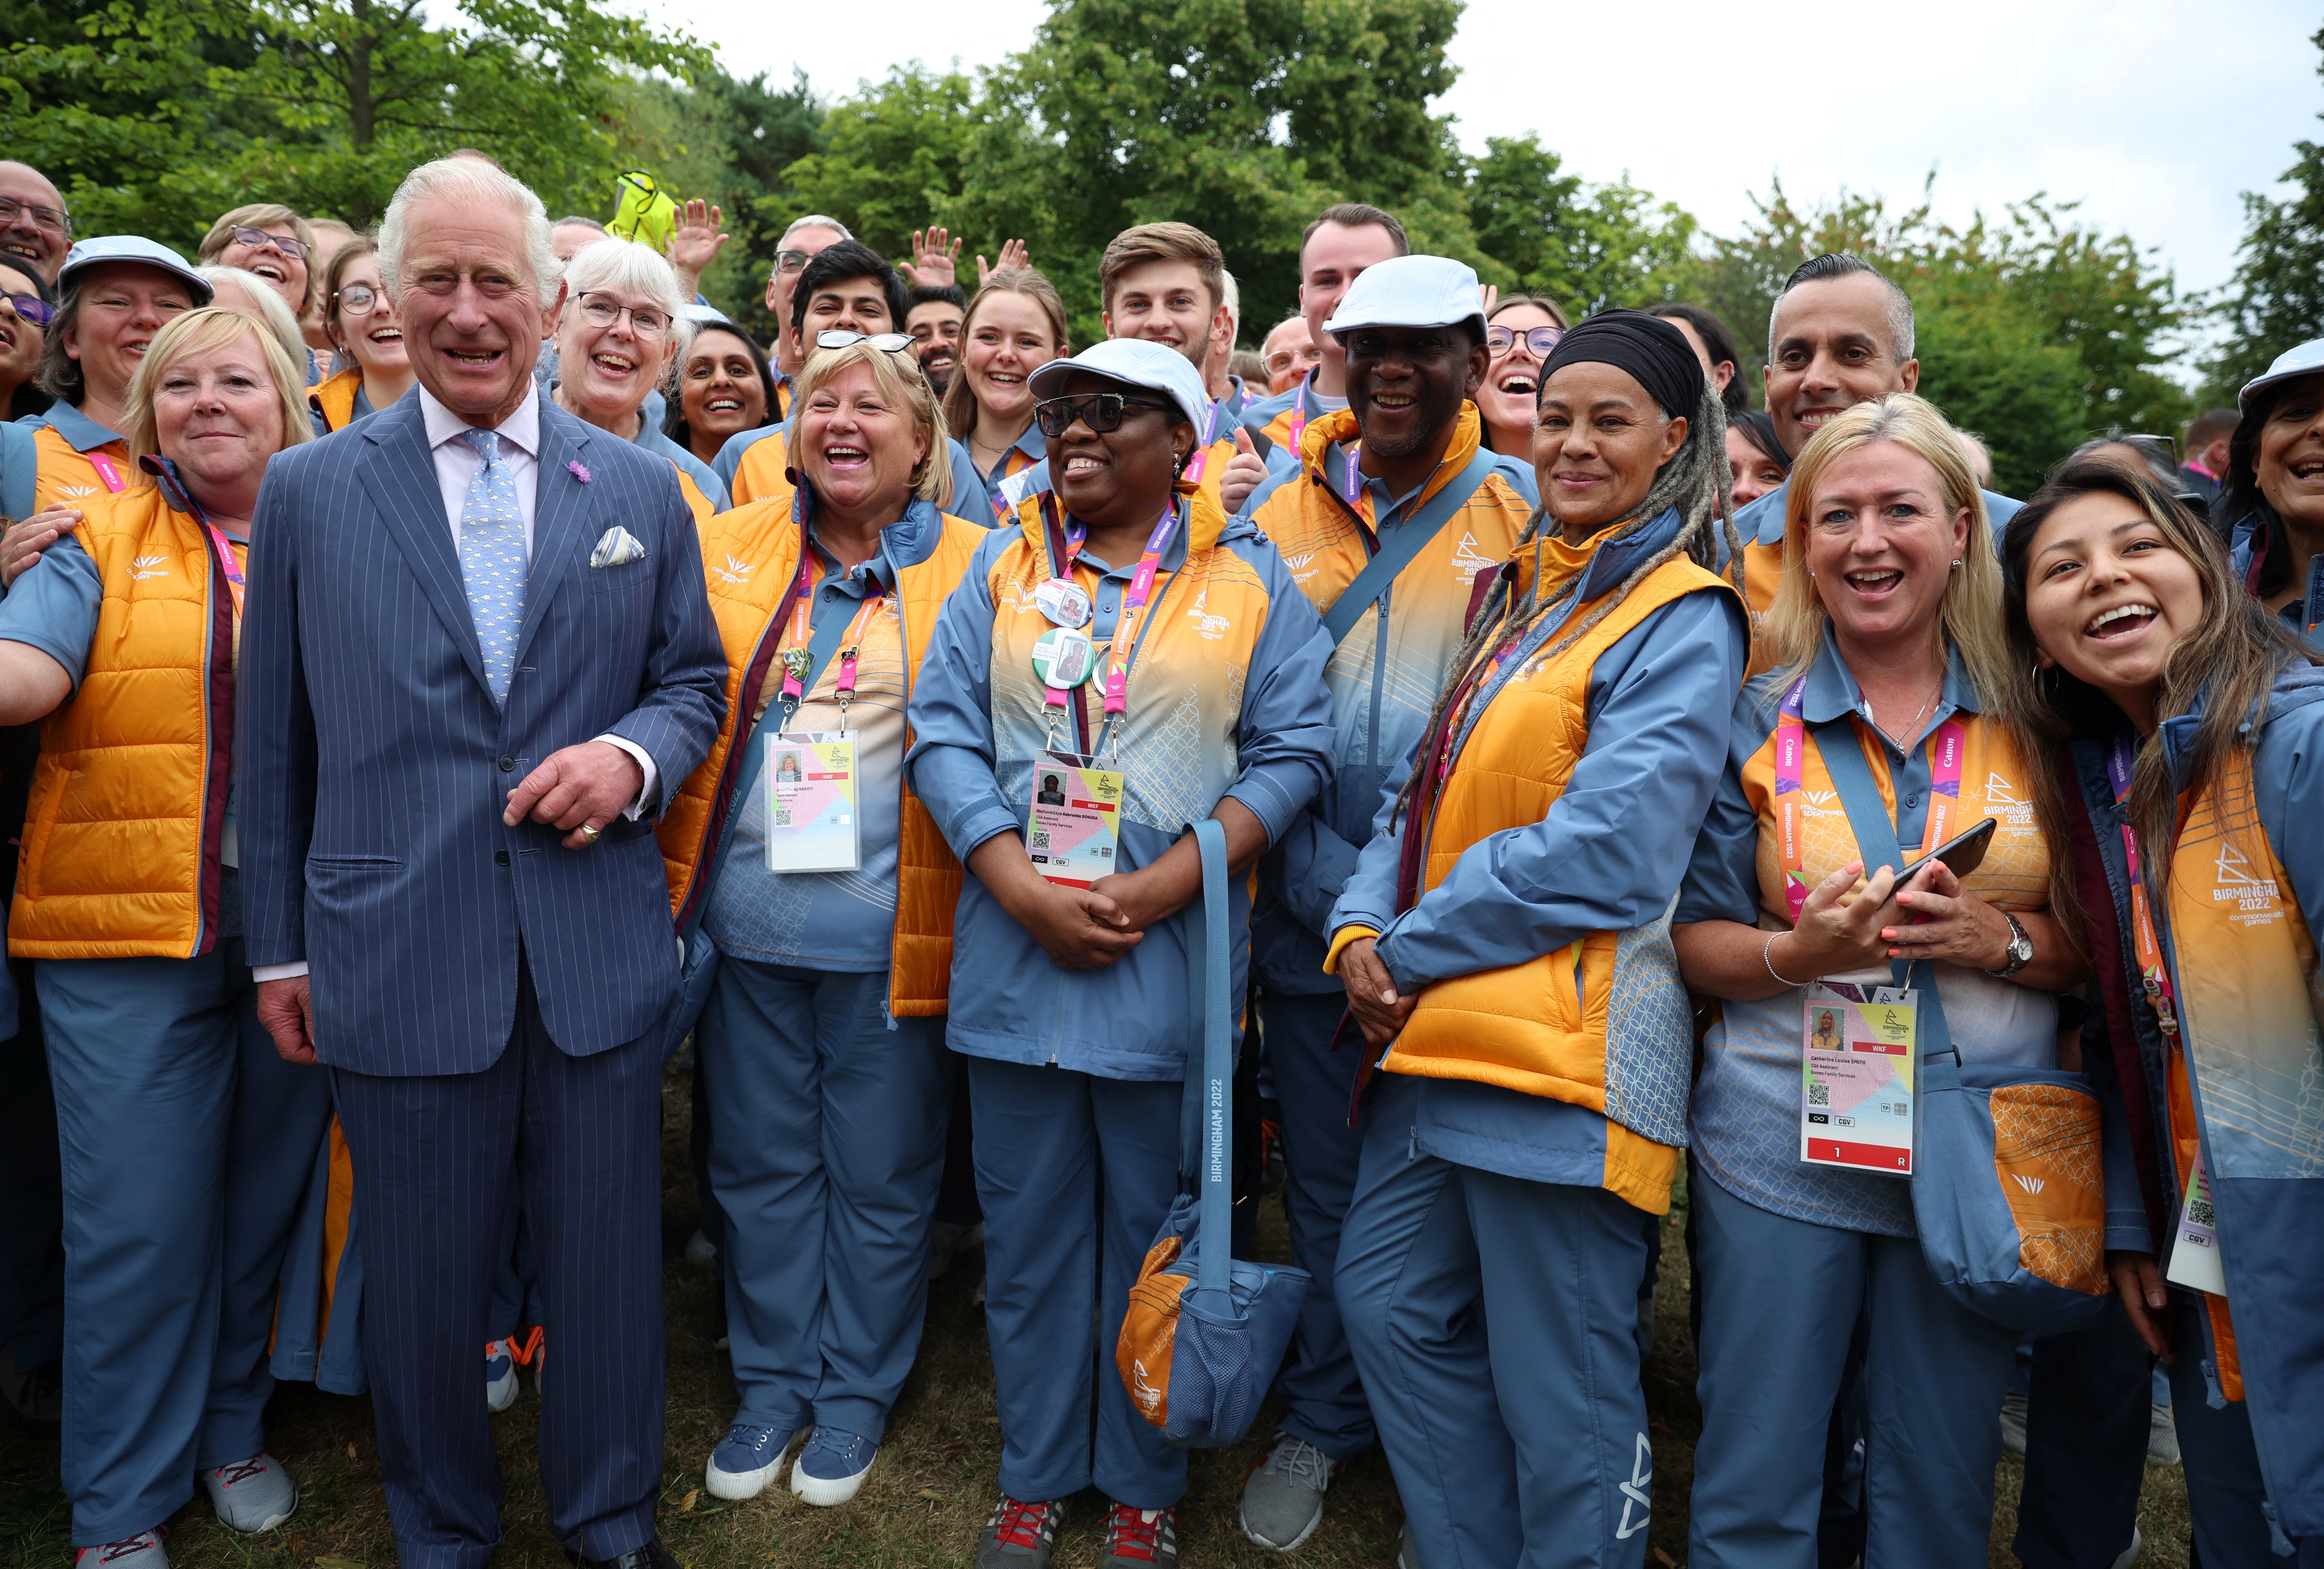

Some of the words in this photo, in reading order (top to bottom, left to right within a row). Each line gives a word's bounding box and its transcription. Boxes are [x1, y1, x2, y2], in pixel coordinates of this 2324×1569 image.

[102, 464, 118, 484] Canon
[1190, 462, 1200, 482] Canon
[1158, 521, 1172, 541] BIRMINGHAM
[221, 542, 232, 564] Canon
[721, 576, 736, 584] sport
[1136, 569, 1149, 589] Canon
[859, 604, 872, 628] BIRMINGHAM
[1122, 617, 1133, 640] RMINGHAM
[1789, 694, 1800, 706] 2022
[1785, 738, 1794, 766] Canon
[1943, 738, 1955, 767] Canon
[729, 788, 741, 814] 2022
[1984, 806, 2033, 815] BIRMINGH
[1937, 805, 1946, 818] 2022
[2006, 814, 2032, 824] 2022
[2213, 884, 2280, 900] BIRMINGHA
[2239, 897, 2271, 910] 2022
[2229, 911, 2285, 921] commonwealth
[2244, 918, 2272, 927] games
[1211, 1078, 1222, 1107] 2022
[1211, 1109, 1222, 1182] BIRMINGHAM
[1834, 1147, 1841, 1158] 1
[1897, 1157, 1906, 1167] R
[2189, 1234, 2205, 1244] CGV
[1143, 1400, 1156, 1410] 2022
